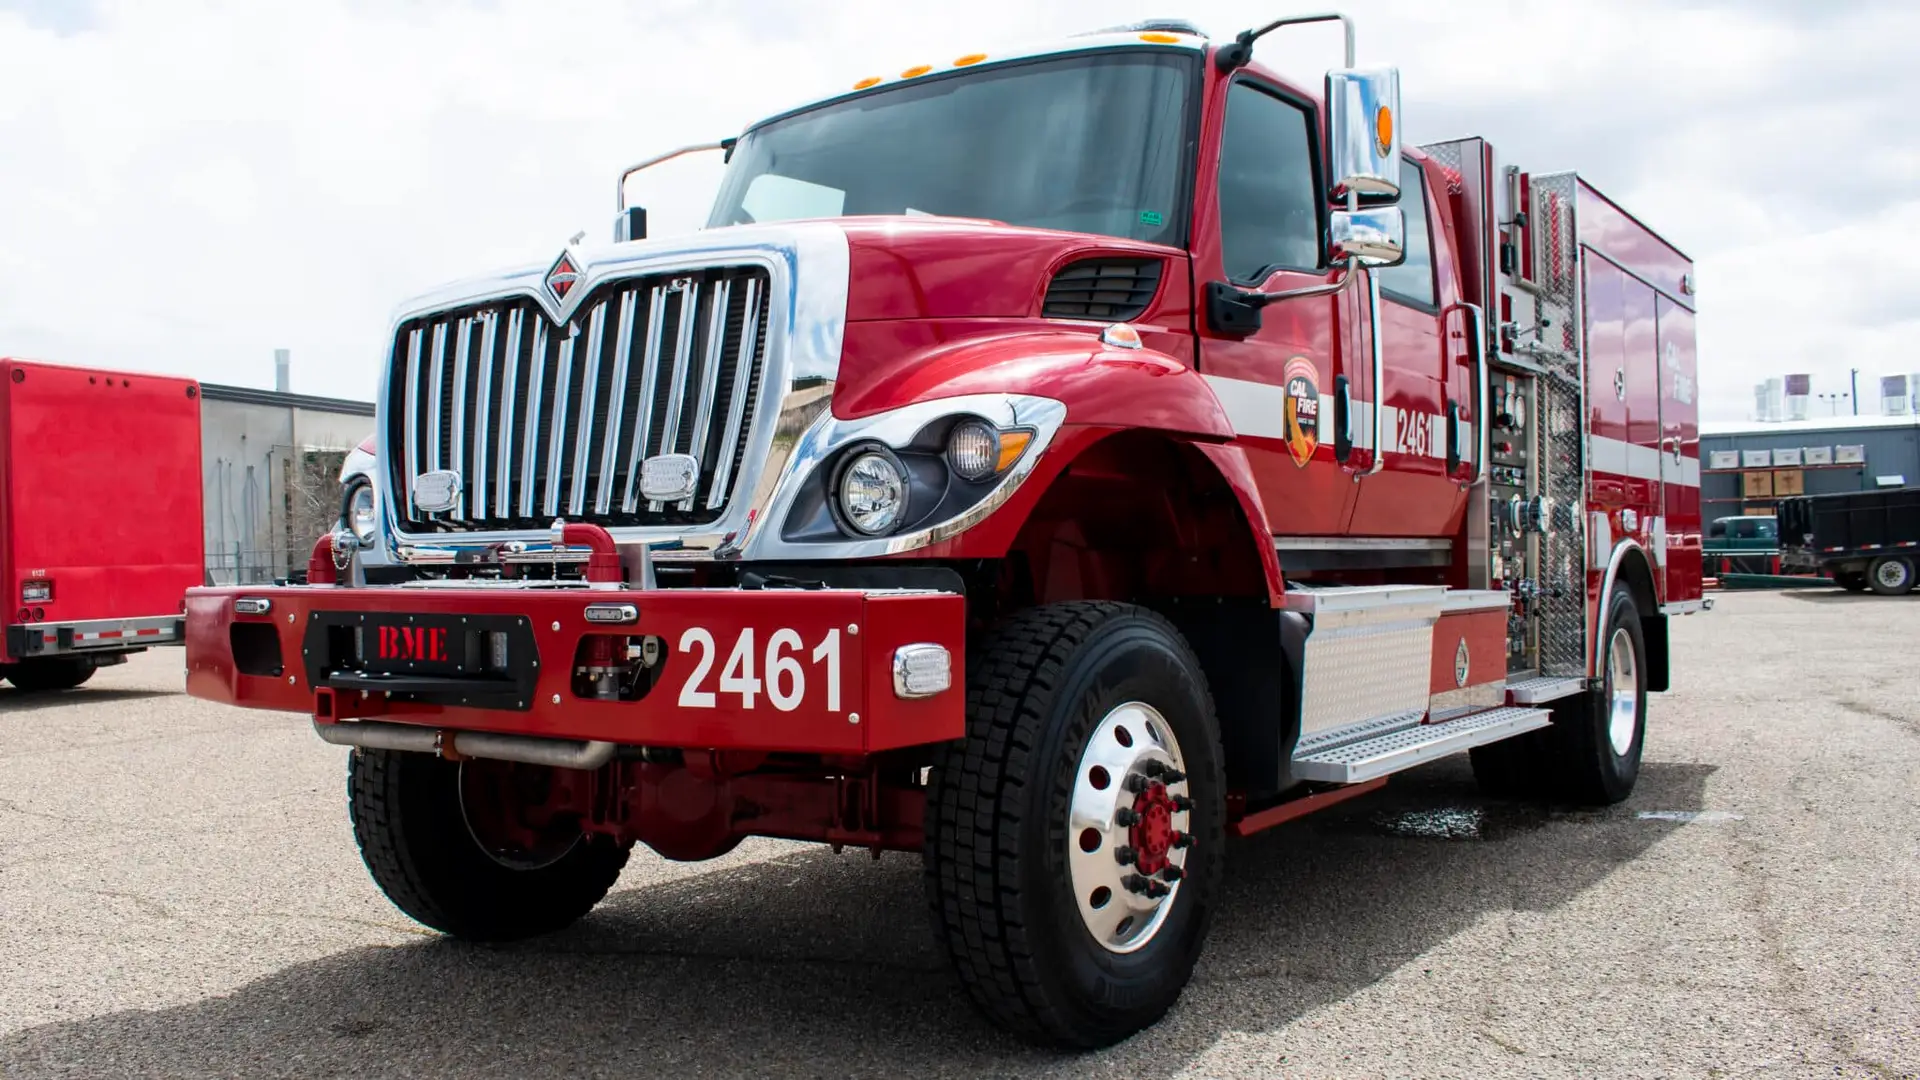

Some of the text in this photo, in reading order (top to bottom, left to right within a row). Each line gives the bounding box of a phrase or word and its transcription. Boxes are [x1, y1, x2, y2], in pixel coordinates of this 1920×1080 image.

[1290, 380, 1307, 397] CAL
[1297, 397, 1317, 415] FIRE
[1398, 408, 1431, 457] 2461
[379, 626, 448, 661] BME
[678, 626, 841, 712] 2461
